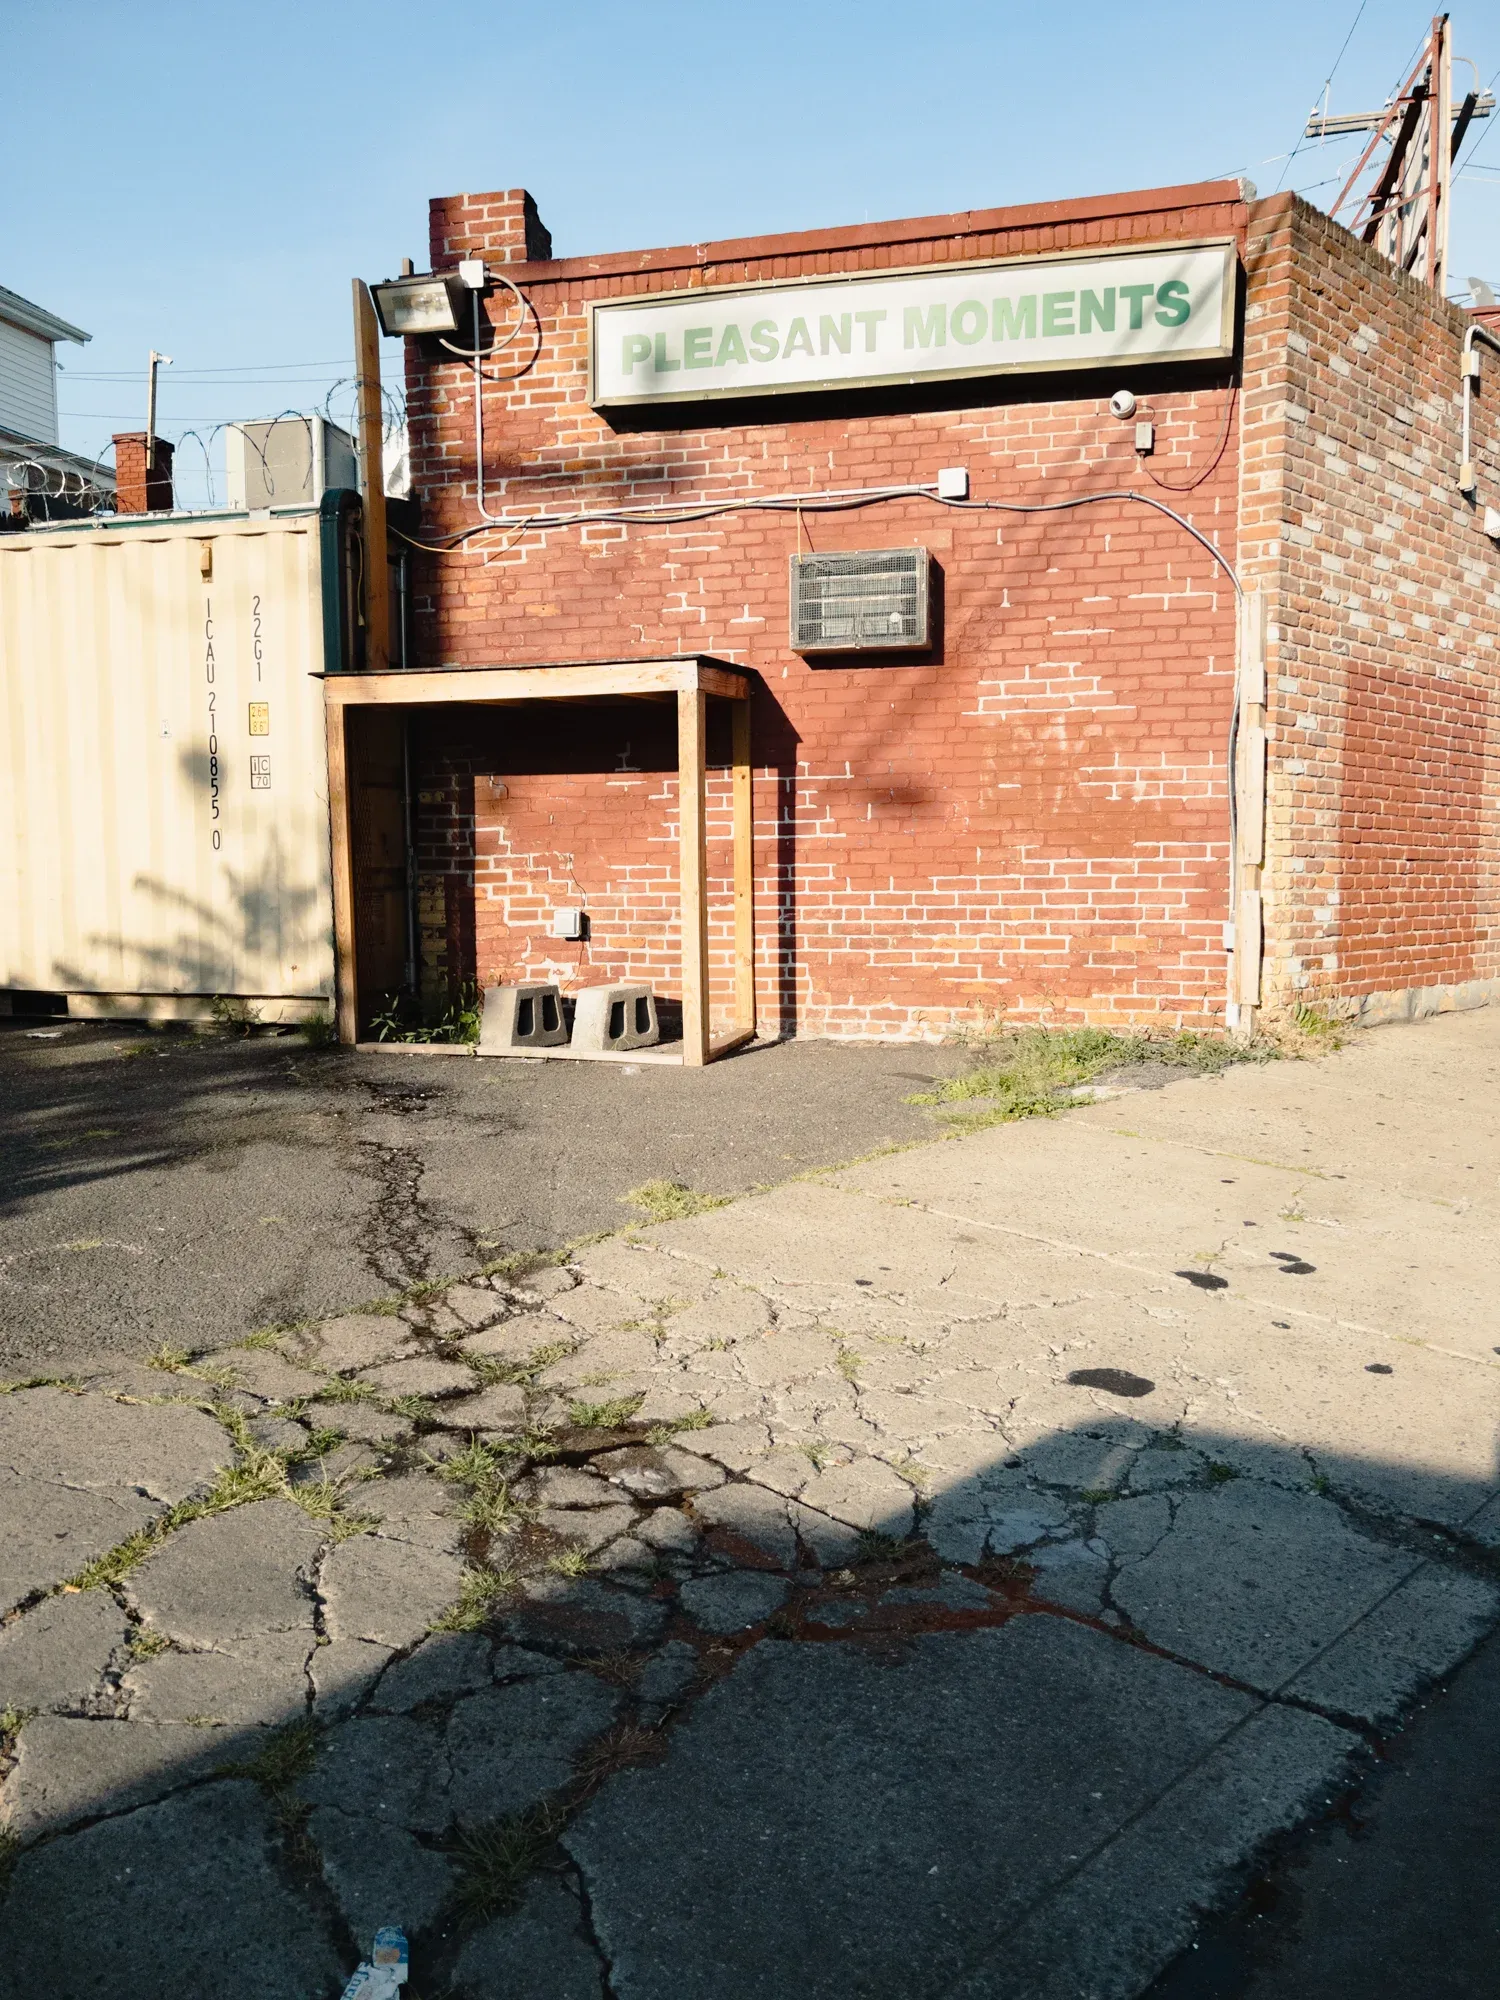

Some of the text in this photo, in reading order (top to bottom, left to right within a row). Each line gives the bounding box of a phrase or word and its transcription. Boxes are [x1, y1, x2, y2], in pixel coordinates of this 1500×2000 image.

[621, 280, 1191, 376] PLEASANT MOMENTS
[205, 597, 215, 684] ICAU
[252, 595, 263, 682] 22G1
[208, 691, 219, 820] 210855
[255, 775, 269, 787] 70
